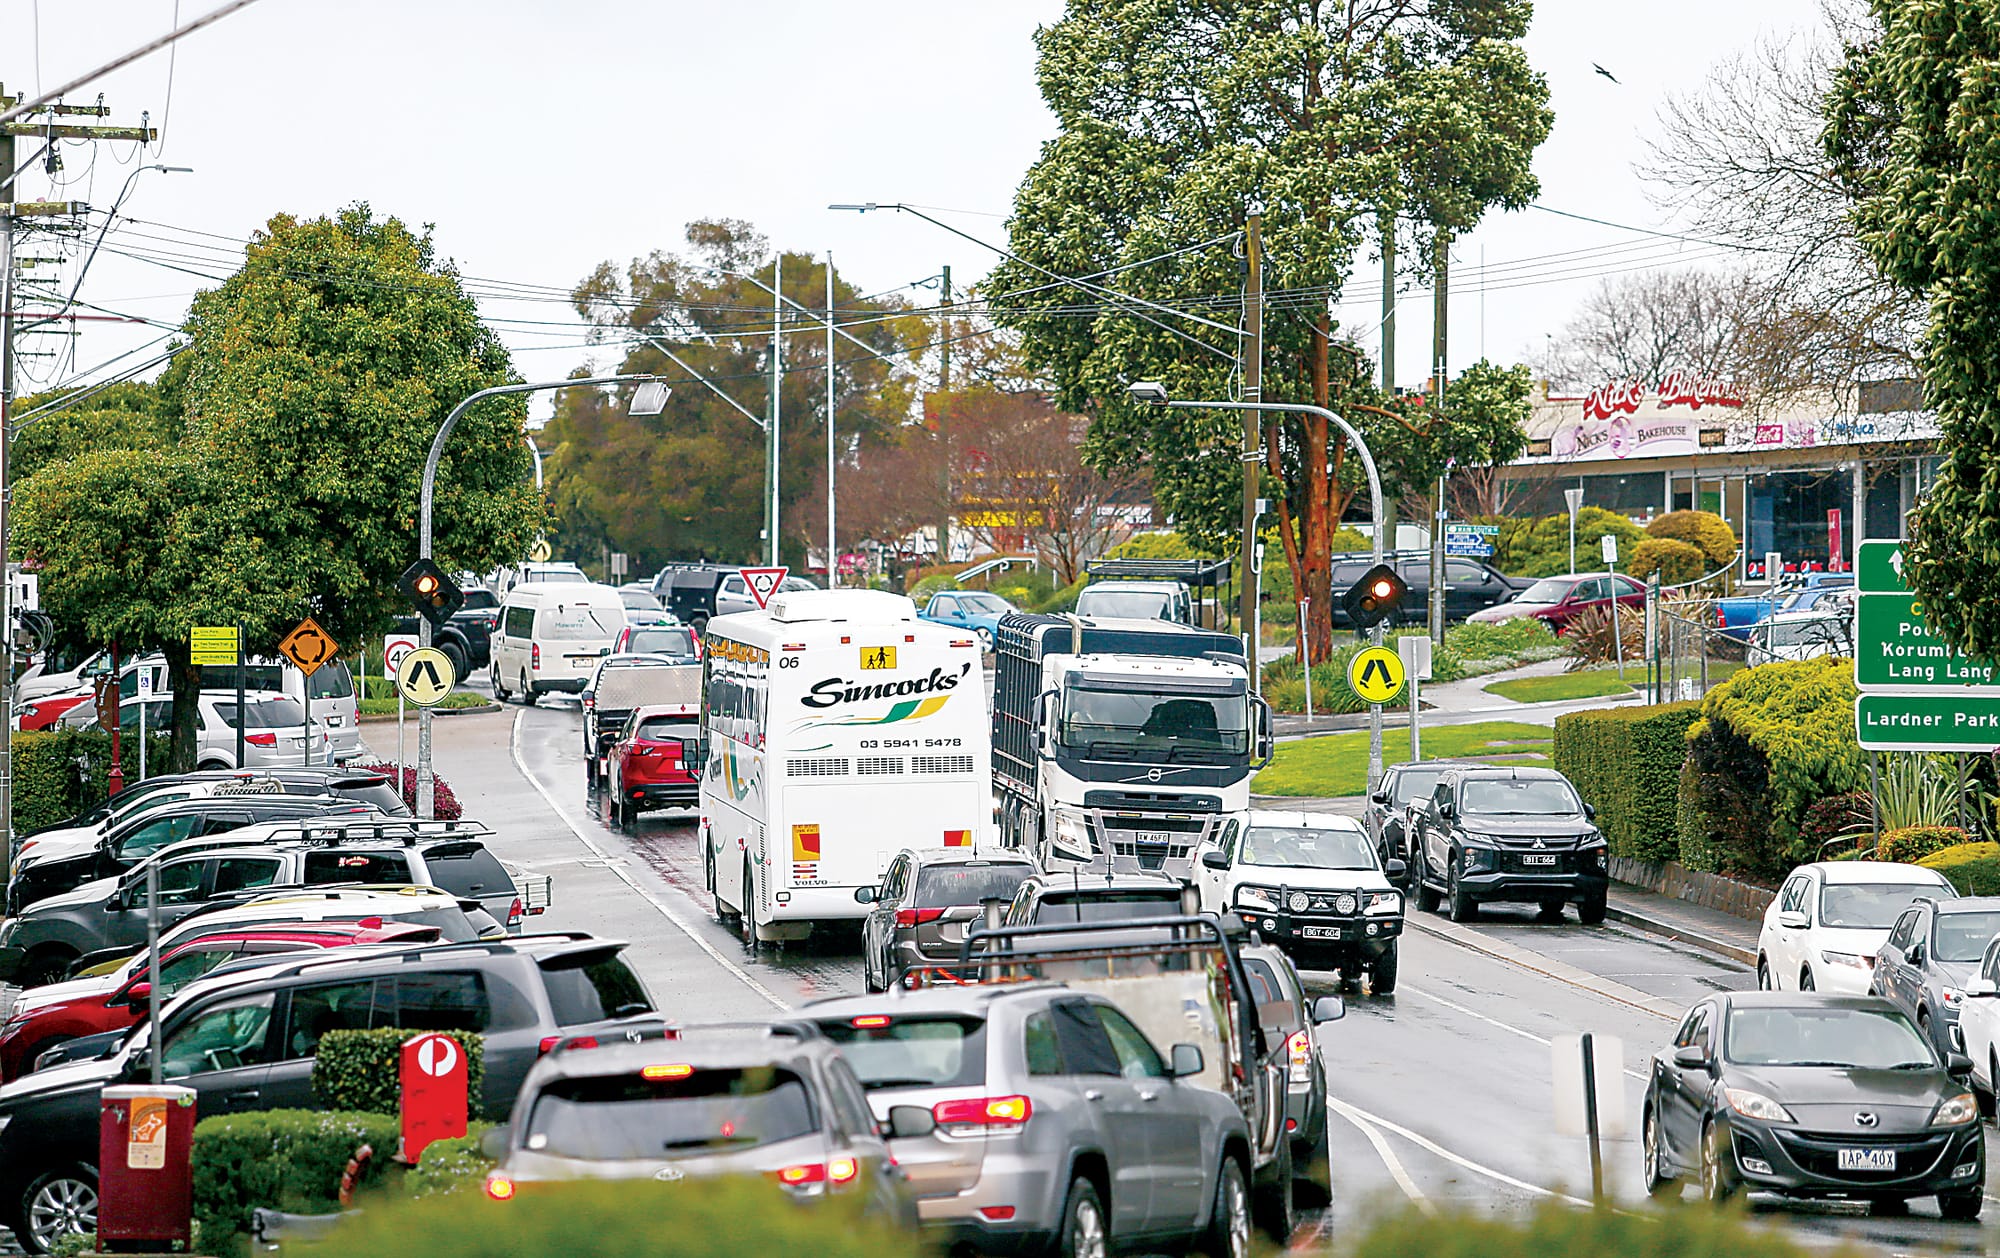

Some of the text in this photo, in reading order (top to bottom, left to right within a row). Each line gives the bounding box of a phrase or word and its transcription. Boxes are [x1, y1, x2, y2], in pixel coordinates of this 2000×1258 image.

[779, 657, 799, 669] 06
[1889, 663, 1992, 682] Lang Lang
[801, 662, 971, 708] Simcocks'
[1867, 711, 1999, 727] Lardner Park
[860, 738, 962, 749] 03 5941 5478
